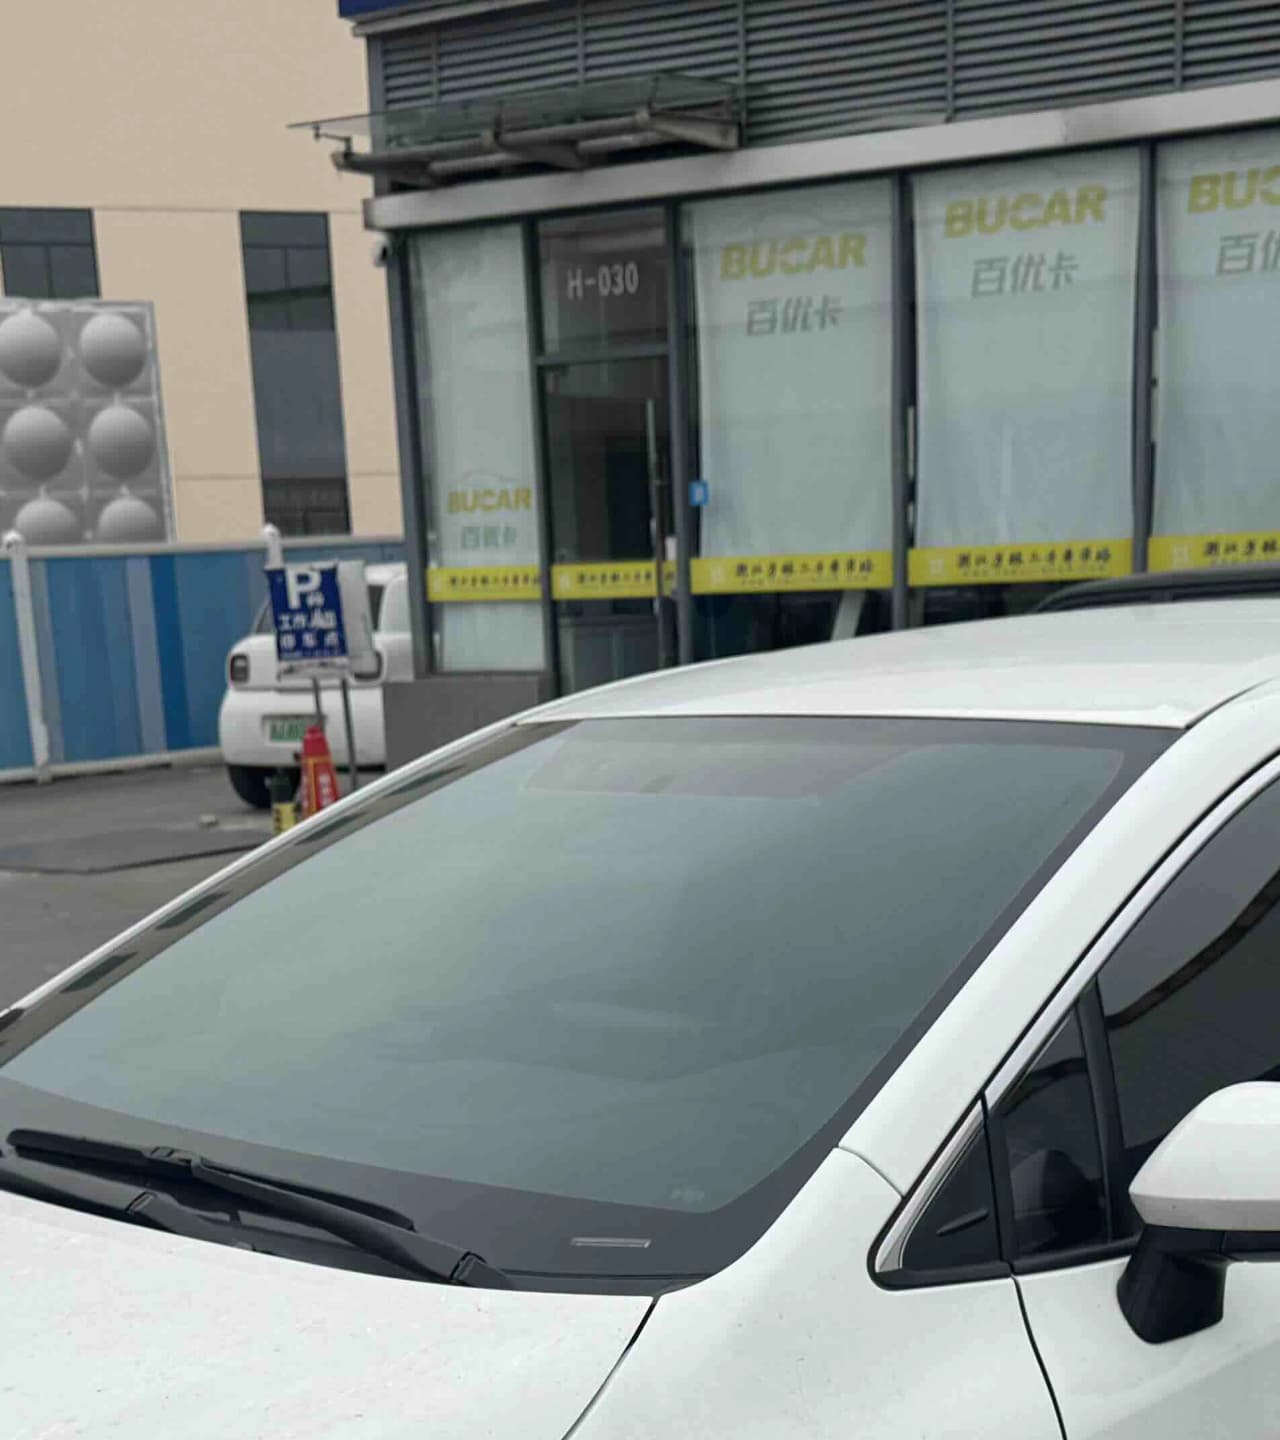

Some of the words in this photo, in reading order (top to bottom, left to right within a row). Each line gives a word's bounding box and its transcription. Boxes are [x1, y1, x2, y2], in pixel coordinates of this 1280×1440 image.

[944, 184, 1108, 239] BUCAR
[720, 232, 867, 281] BUCAR
[971, 250, 1080, 299] 百优卡
[567, 262, 639, 299] H-030
[745, 295, 844, 337] 百优卡
[447, 487, 531, 514] BUCAR
[284, 566, 321, 609] P
